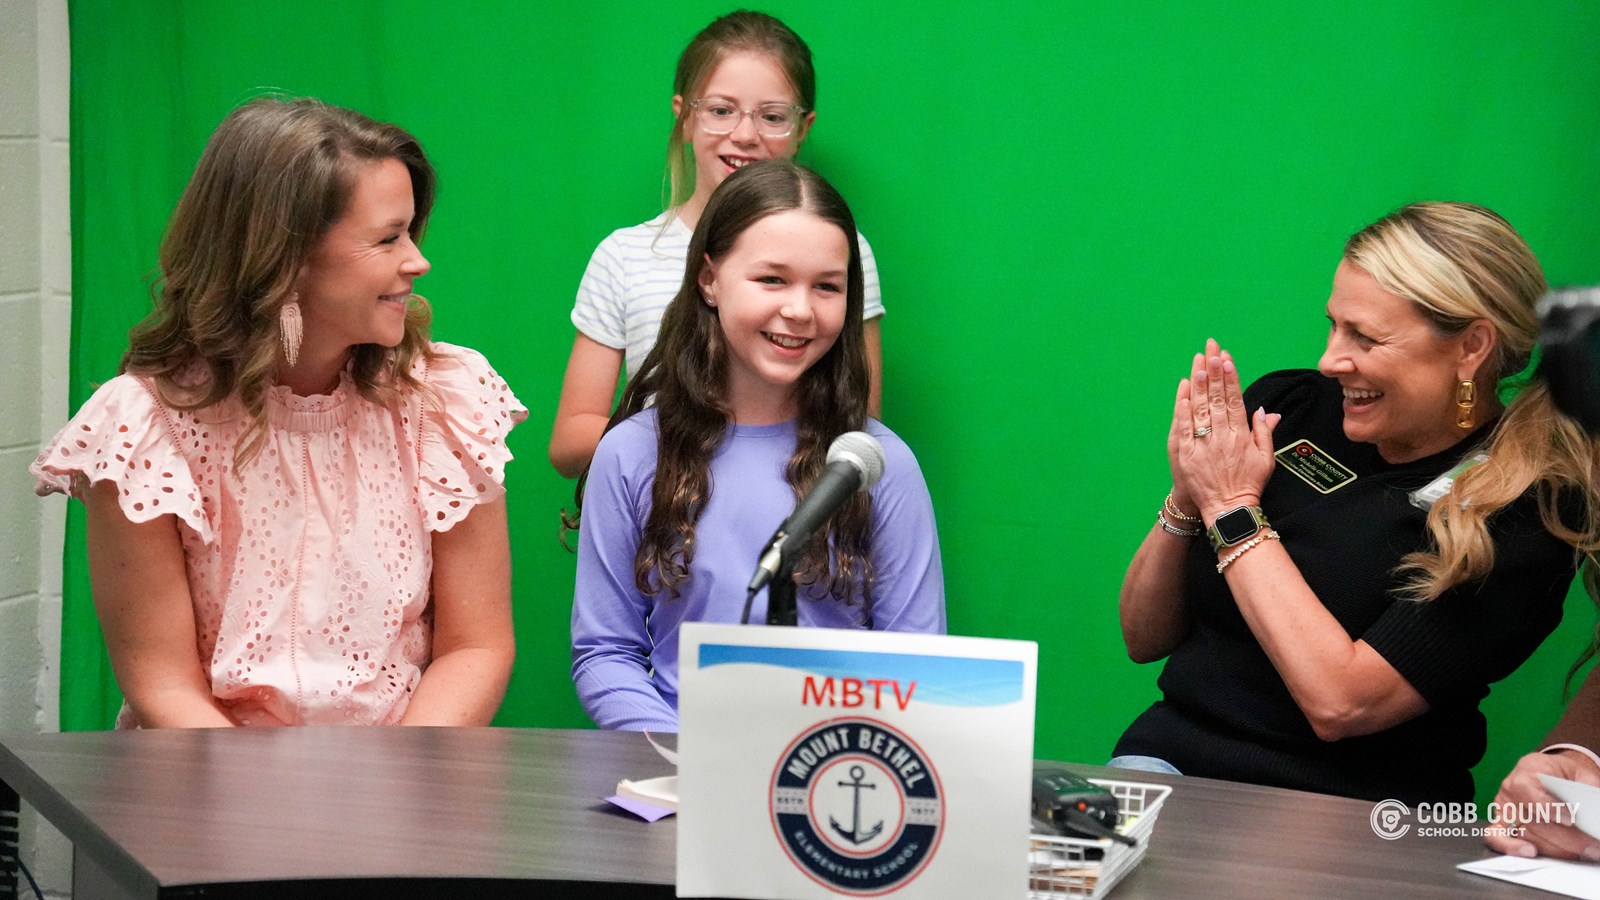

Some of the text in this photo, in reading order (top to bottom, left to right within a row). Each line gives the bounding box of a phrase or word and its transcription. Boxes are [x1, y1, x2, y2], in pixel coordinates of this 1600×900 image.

[1325, 463, 1349, 480] COUNTY
[802, 676, 917, 711] MBTV
[787, 727, 926, 789] MOUNT BETHEL
[794, 831, 919, 880] ELEMENTARY SCHOOL
